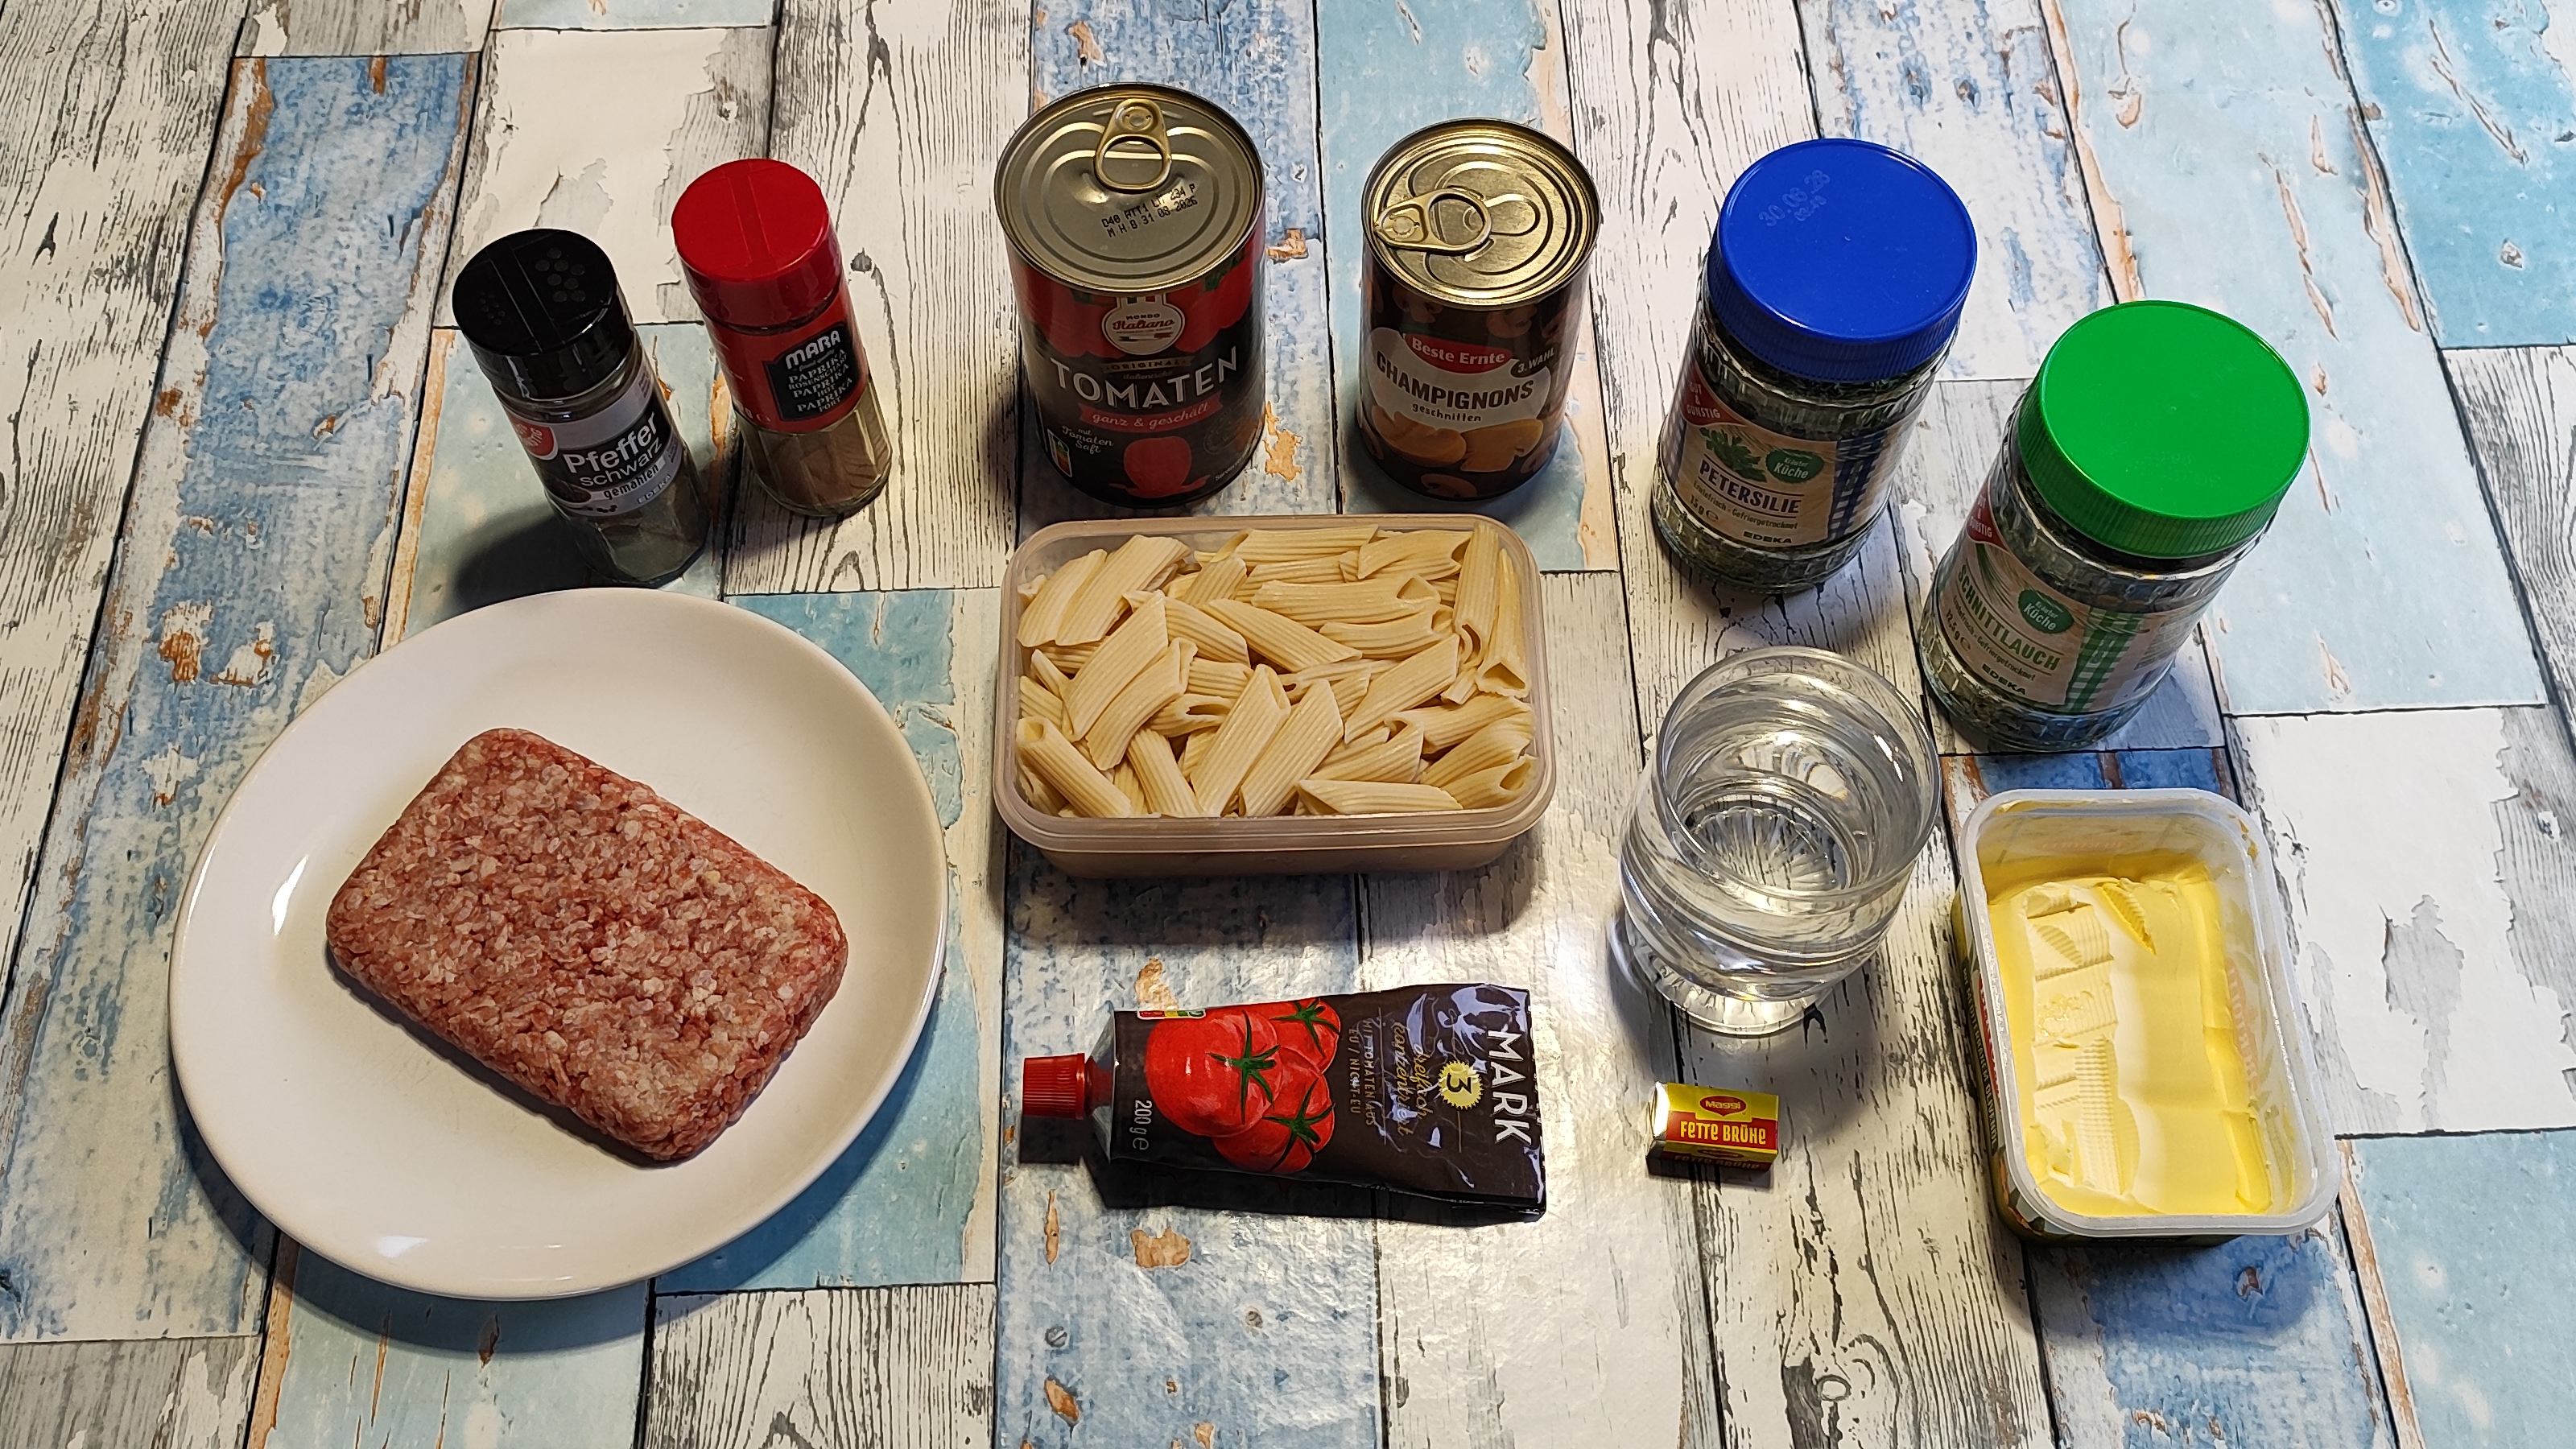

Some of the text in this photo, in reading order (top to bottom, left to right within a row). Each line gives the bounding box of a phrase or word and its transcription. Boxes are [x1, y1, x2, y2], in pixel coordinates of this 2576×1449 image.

[1112, 319, 1175, 330] Italiano
[786, 330, 840, 369] MARA
[1111, 359, 1180, 370] ORIGINAL
[1411, 337, 1505, 365] Beste Ernte
[789, 349, 845, 384] PAPRIKA
[793, 364, 849, 398] PAPRIKA
[1051, 345, 1237, 409] TOMATEN
[1377, 350, 1534, 410] CHAMPIGNONS
[797, 378, 852, 412] PAPRIKA
[818, 383, 835, 398] HOT
[1092, 402, 1209, 430] ganz & geschält
[1412, 402, 1482, 423] geschnitten
[562, 411, 658, 474] Pfeffer
[1062, 425, 1114, 447] Tomaten
[1075, 440, 1102, 455] Saft
[580, 437, 663, 487] schwarz
[1773, 462, 1809, 480] Küche
[604, 464, 660, 501] gemahlen
[638, 474, 671, 504] EDEKA
[1699, 459, 1802, 514] PETERSILIE
[1743, 530, 1793, 544] EDEKA
[1957, 564, 2061, 671] SCHNITTLAUCH
[2024, 603, 2057, 631] Küche
[1982, 663, 2026, 696] EDEKA
[1348, 1029, 1359, 1043] EU
[1349, 1059, 1361, 1114] NICHT-EU
[1364, 1045, 1376, 1099] TOMATEN
[1390, 1021, 1414, 1137] konzentriert
[1410, 1042, 1433, 1120] dreifach
[1446, 1073, 1472, 1095] 3
[1487, 1030, 1532, 1146] MARK
[1129, 1100, 1153, 1135] 200 g
[1705, 1099, 1741, 1109] Maggi
[1680, 1121, 1766, 1145] FETTE BRÜHE
